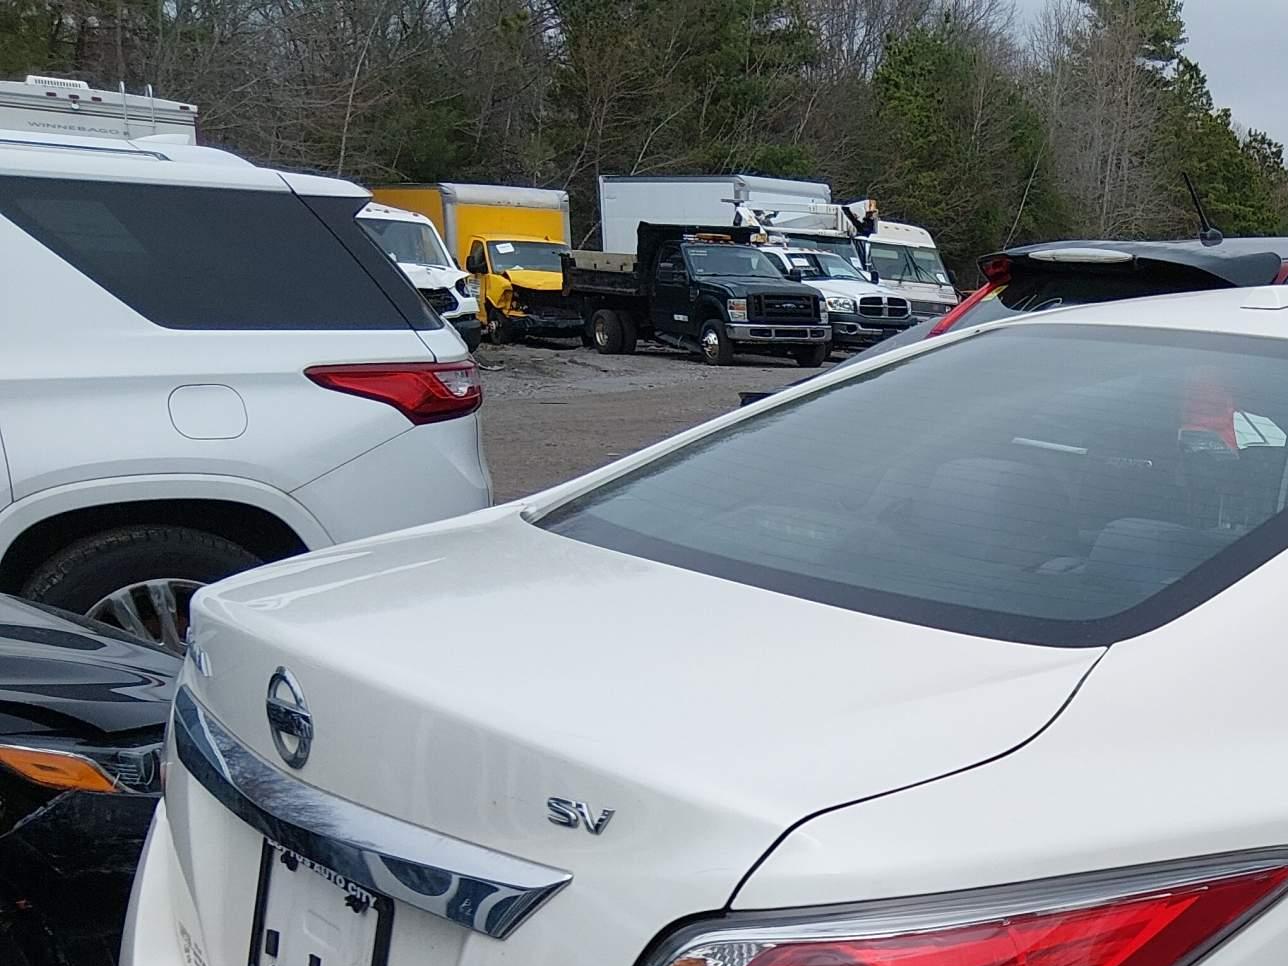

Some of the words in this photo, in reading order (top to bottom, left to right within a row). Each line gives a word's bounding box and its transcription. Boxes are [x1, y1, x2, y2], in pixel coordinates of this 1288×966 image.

[27, 121, 119, 134] WINNEBAGO
[547, 797, 616, 835] SV
[313, 862, 345, 888] AUTO
[348, 882, 377, 907] CITY
